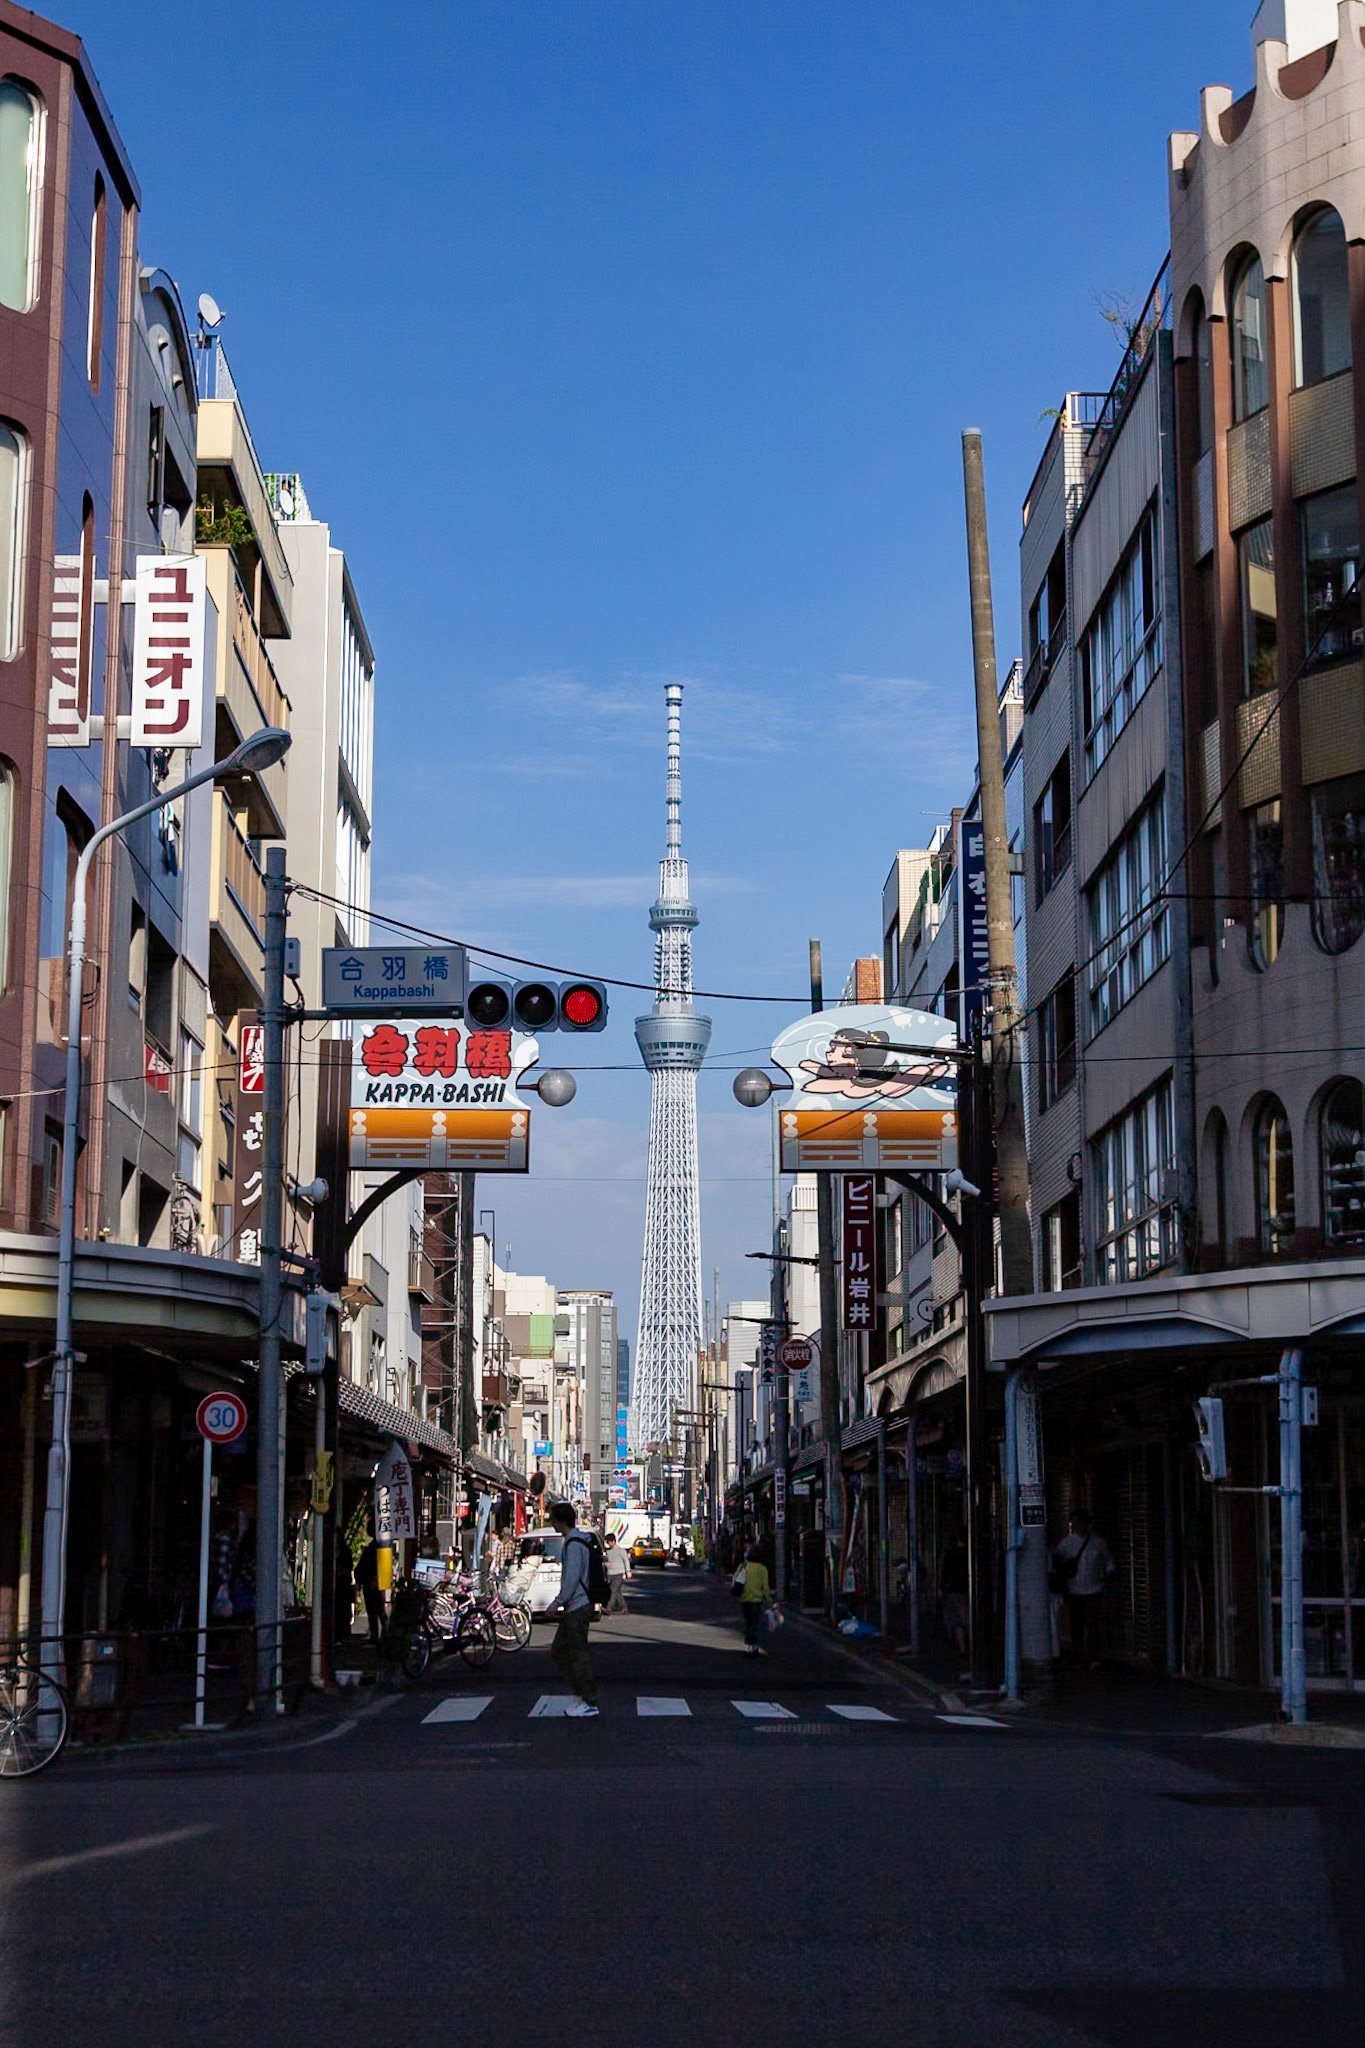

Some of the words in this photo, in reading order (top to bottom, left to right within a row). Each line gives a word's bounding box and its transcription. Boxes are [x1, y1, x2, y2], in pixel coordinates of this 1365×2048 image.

[143, 568, 194, 735] ユニオン
[339, 955, 449, 981] 合羽橋
[354, 984, 435, 1000] Kappabashi
[362, 1025, 513, 1079] 合羽橋
[847, 1180, 872, 1325] ビニール岩井
[784, 1348, 811, 1362] 消火栓
[208, 1407, 236, 1428] 30
